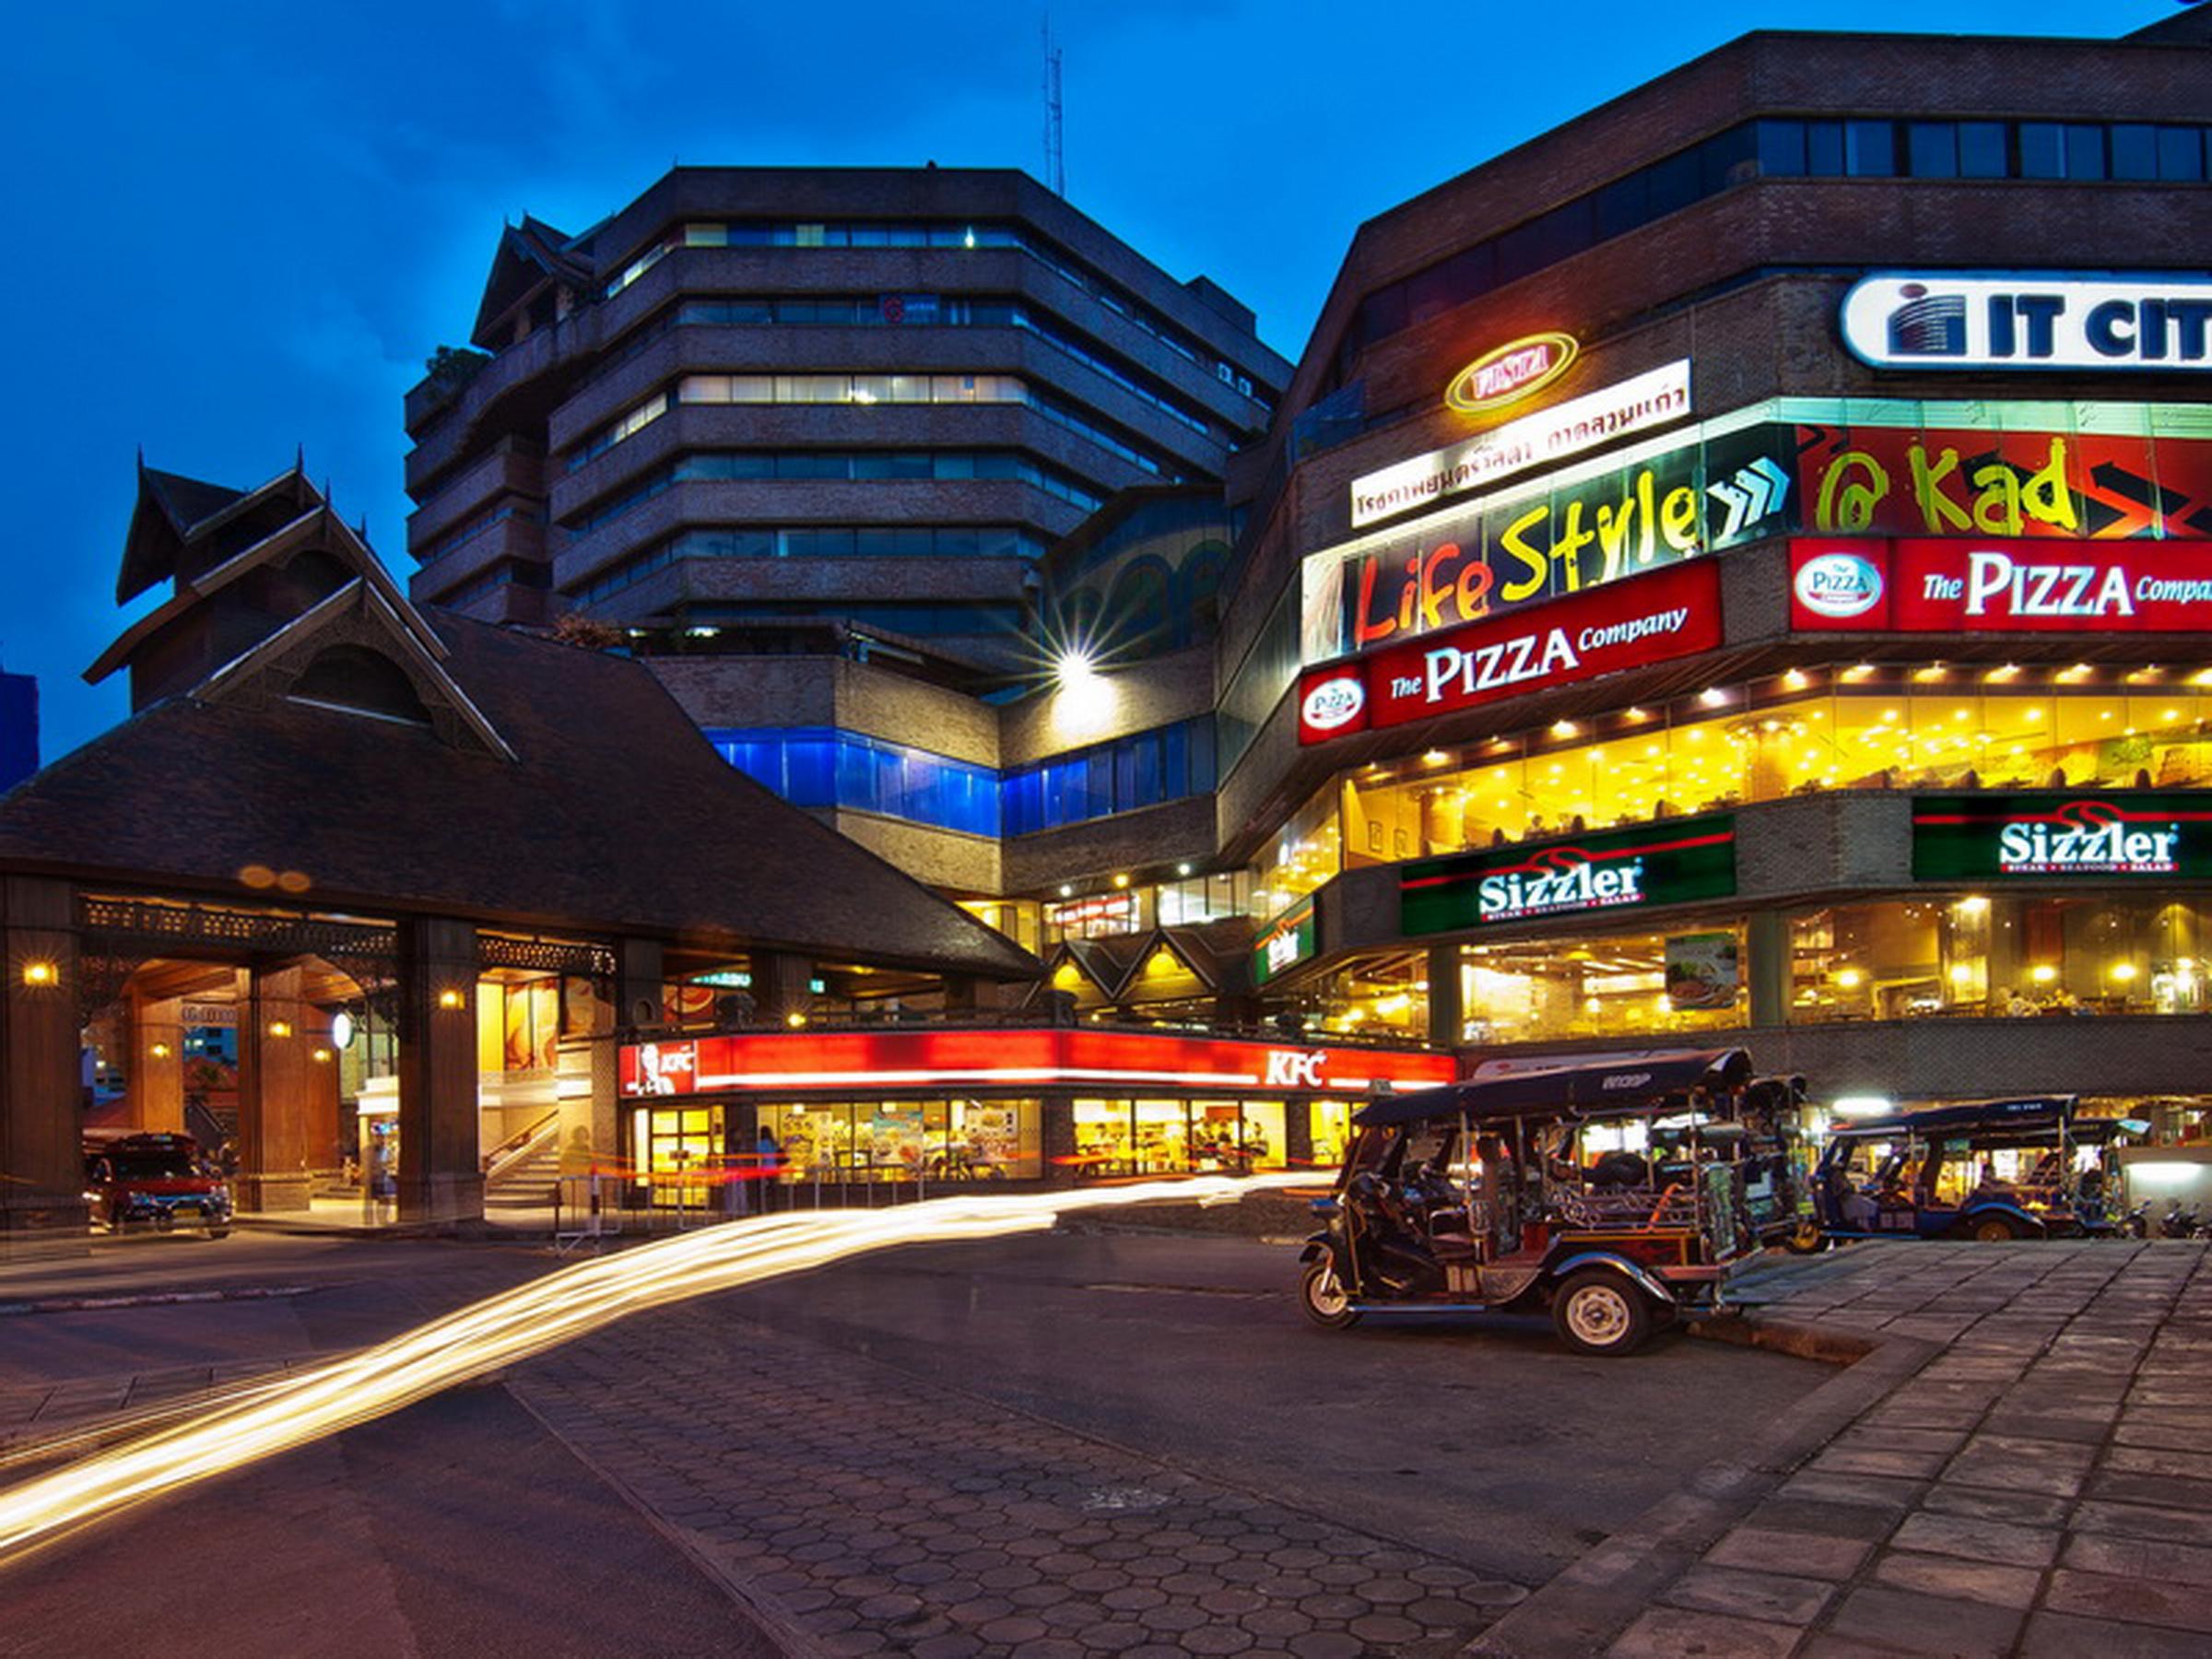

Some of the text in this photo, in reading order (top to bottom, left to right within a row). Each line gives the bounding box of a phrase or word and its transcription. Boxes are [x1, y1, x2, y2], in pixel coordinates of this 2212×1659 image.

[1987, 294, 2212, 360] IT CIT
[1907, 437, 2079, 536] Kad
[1924, 573, 1964, 600] The
[1964, 552, 2136, 616] PIZZA
[1390, 606, 1688, 704] The PIZZA Company
[1999, 821, 2179, 863] Sizzler
[1478, 860, 1643, 914] Sizzler
[1265, 1050, 1327, 1087] KFC
